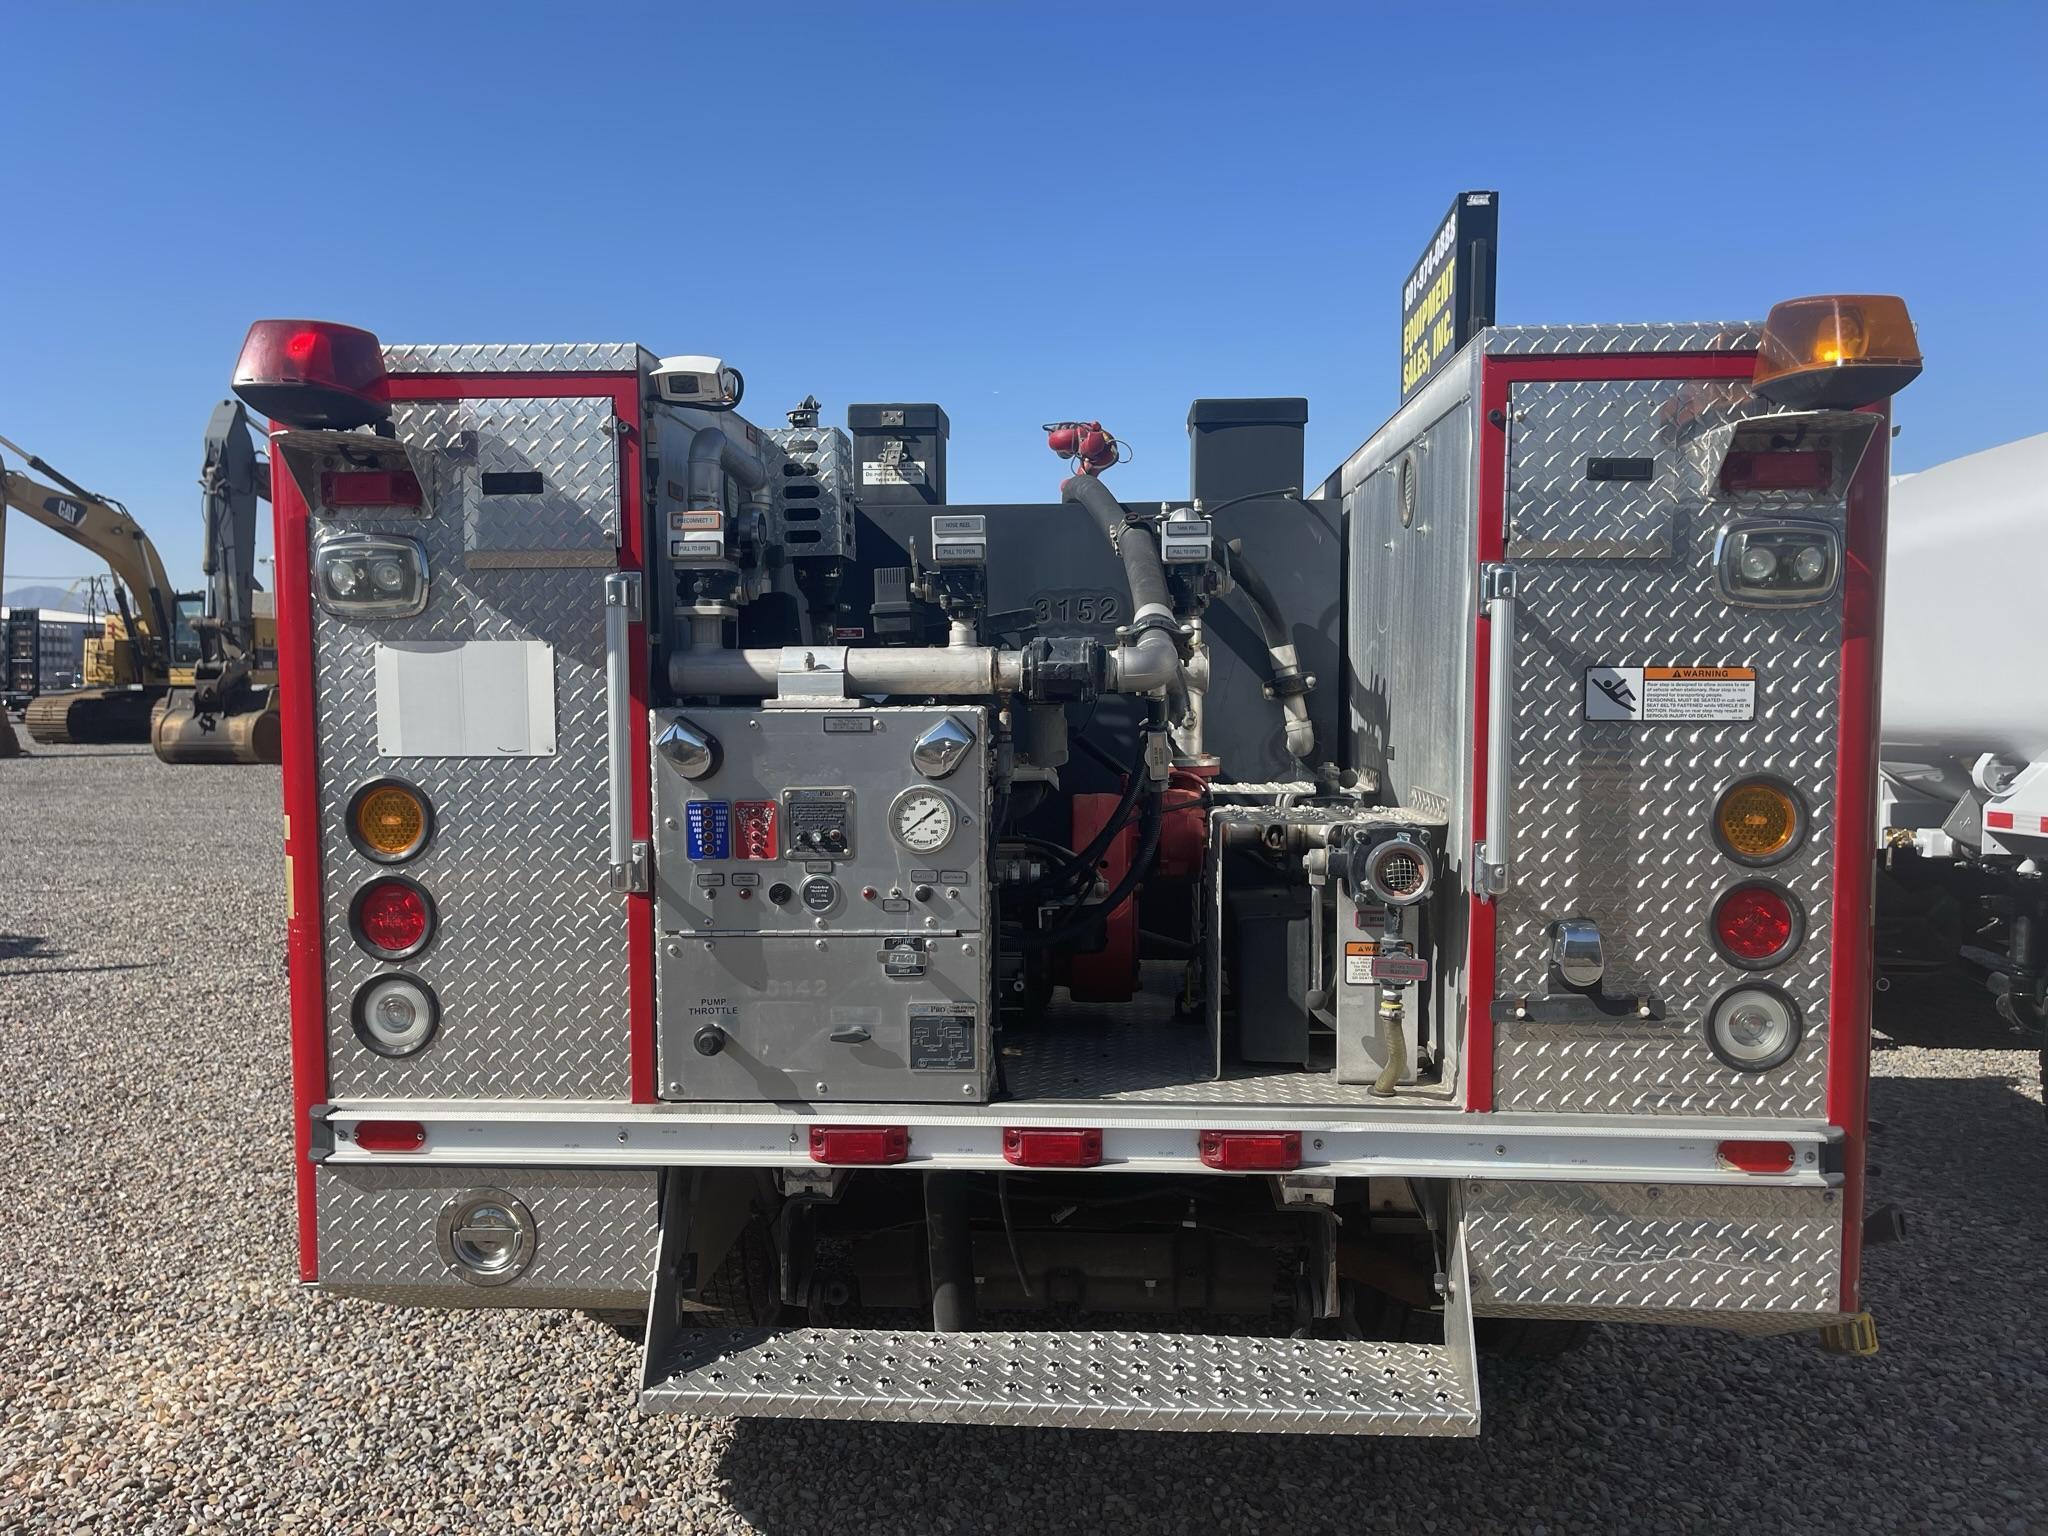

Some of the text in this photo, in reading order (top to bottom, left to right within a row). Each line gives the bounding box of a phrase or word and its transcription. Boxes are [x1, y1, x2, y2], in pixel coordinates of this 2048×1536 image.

[1404, 257, 1456, 356] EQUIPMENT
[1403, 309, 1454, 394] SALES, INC.
[58, 499, 77, 523] CAT
[1034, 596, 1119, 624] 3152
[1684, 670, 1728, 678] WARNING
[688, 1007, 738, 1015] THROTTLE
